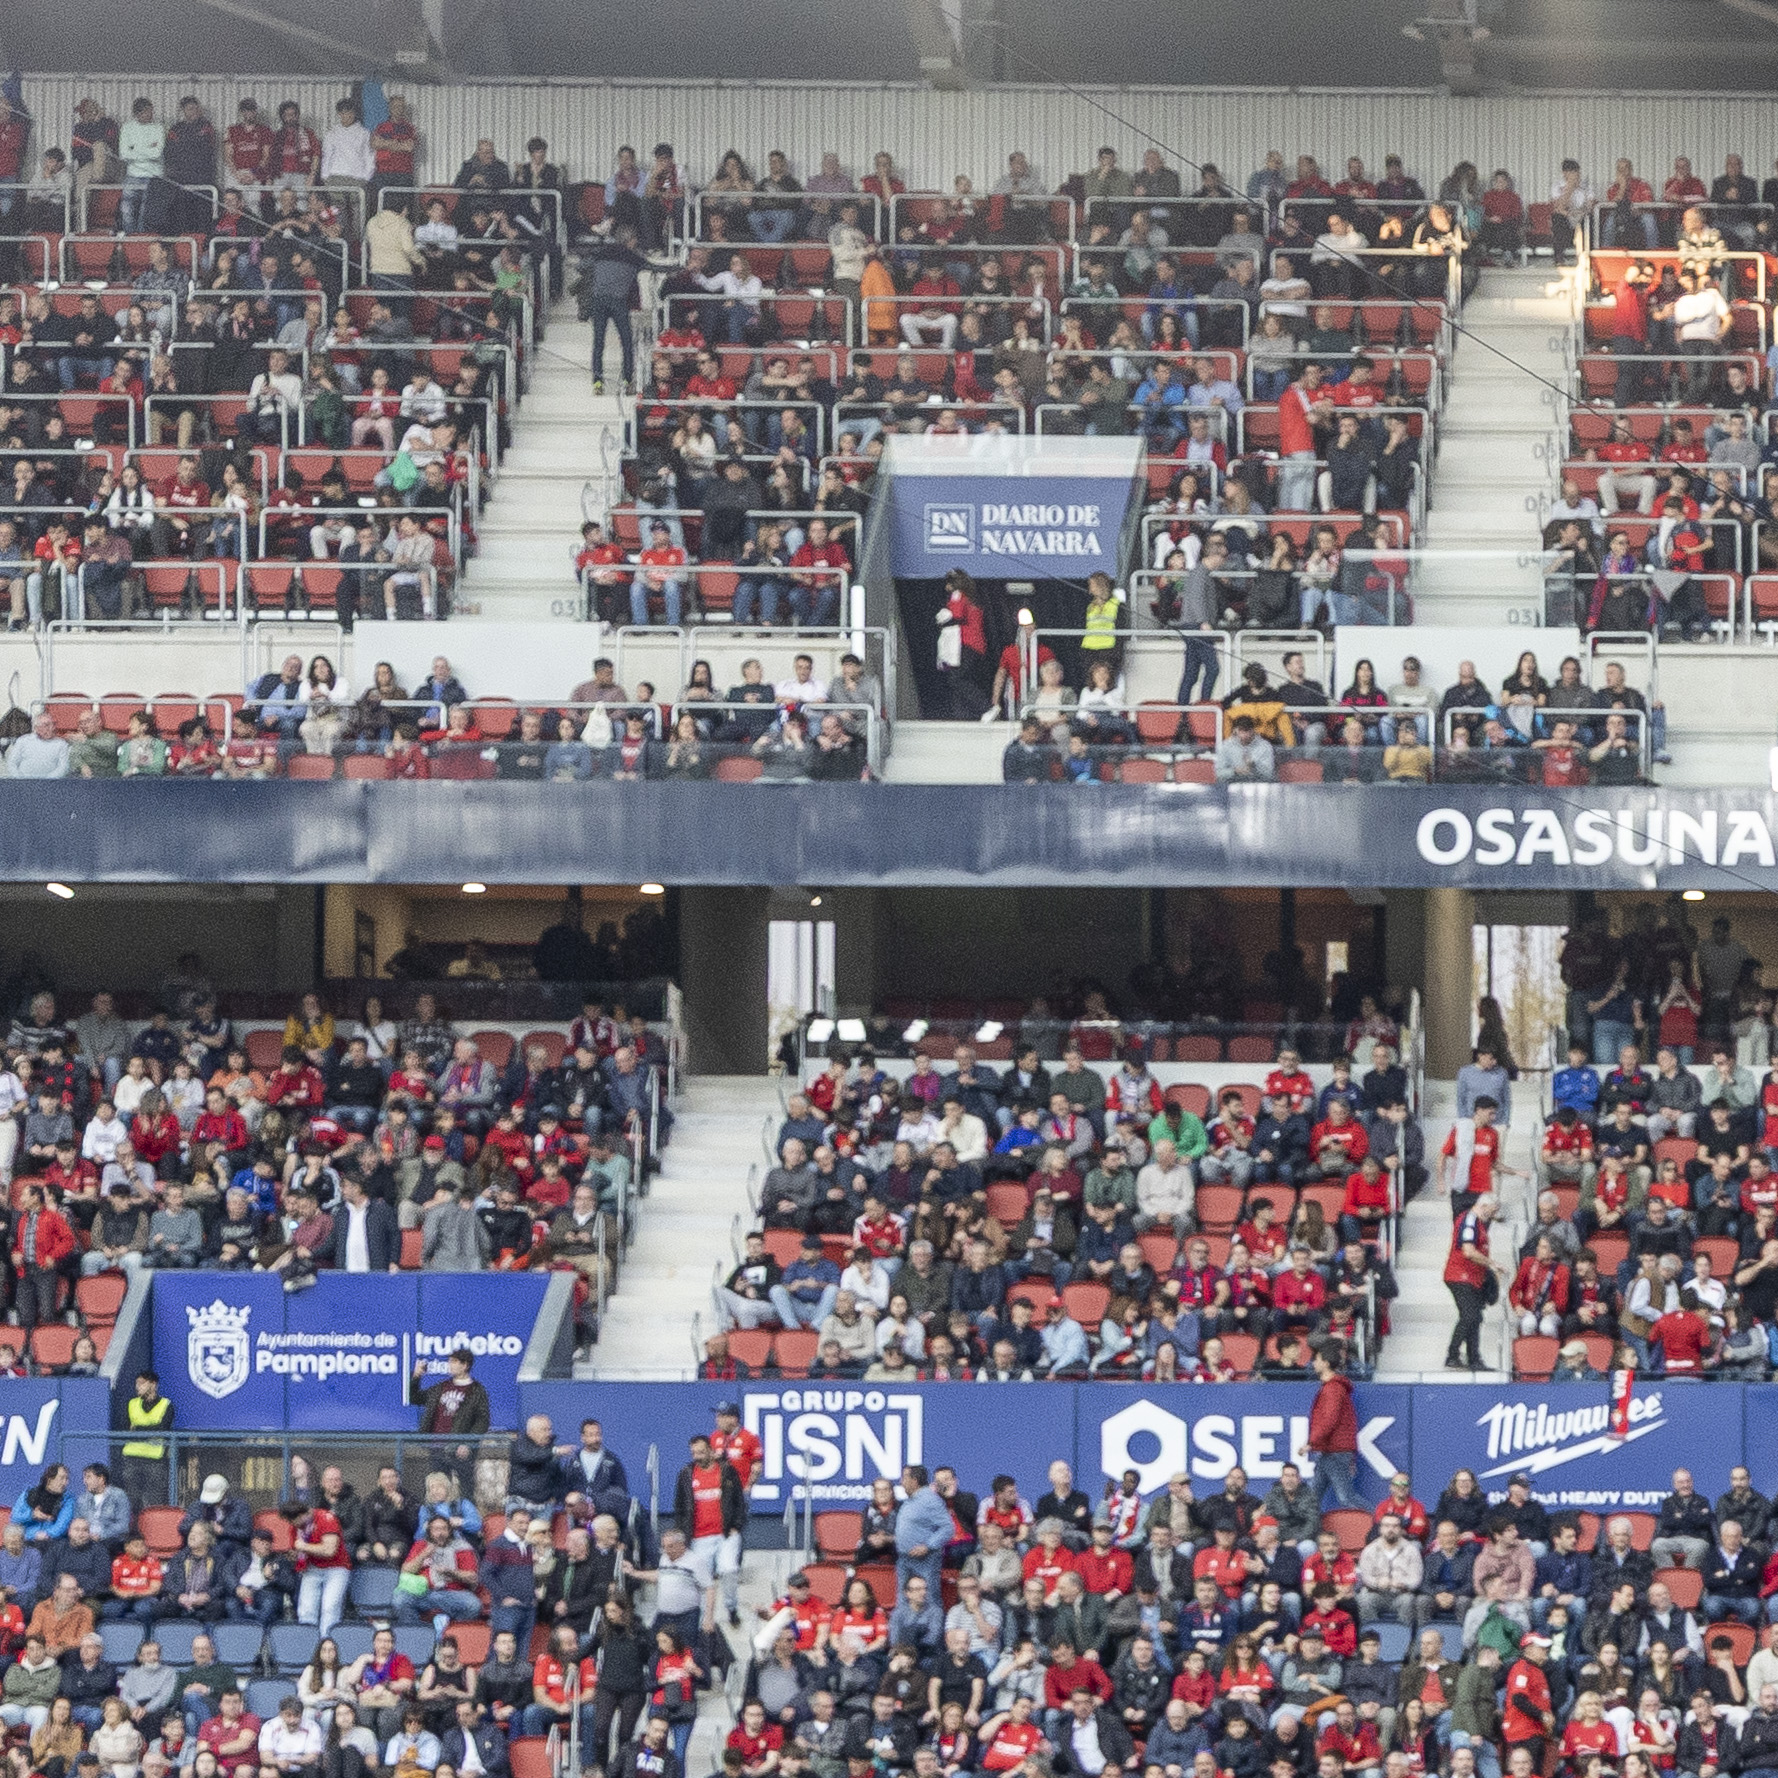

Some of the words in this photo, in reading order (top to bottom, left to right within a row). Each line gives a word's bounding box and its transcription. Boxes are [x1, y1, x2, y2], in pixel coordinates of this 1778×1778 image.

[930, 511, 967, 533] DN
[982, 504, 1060, 527] DIARIO
[1061, 505, 1100, 528] DE
[982, 530, 1102, 555] NAVARRA
[1416, 808, 1777, 868] OSASUNA
[256, 1331, 371, 1351] Ayuntamiento
[376, 1332, 397, 1347] de
[415, 1331, 522, 1356] Iruñeko
[256, 1350, 397, 1380] Pamplona
[782, 1391, 888, 1412] GRUPO
[0, 1398, 60, 1466] N
[1477, 1394, 1663, 1459] Milwauee
[765, 1414, 903, 1482] ISN
[1560, 1491, 1620, 1506] HEAVY
